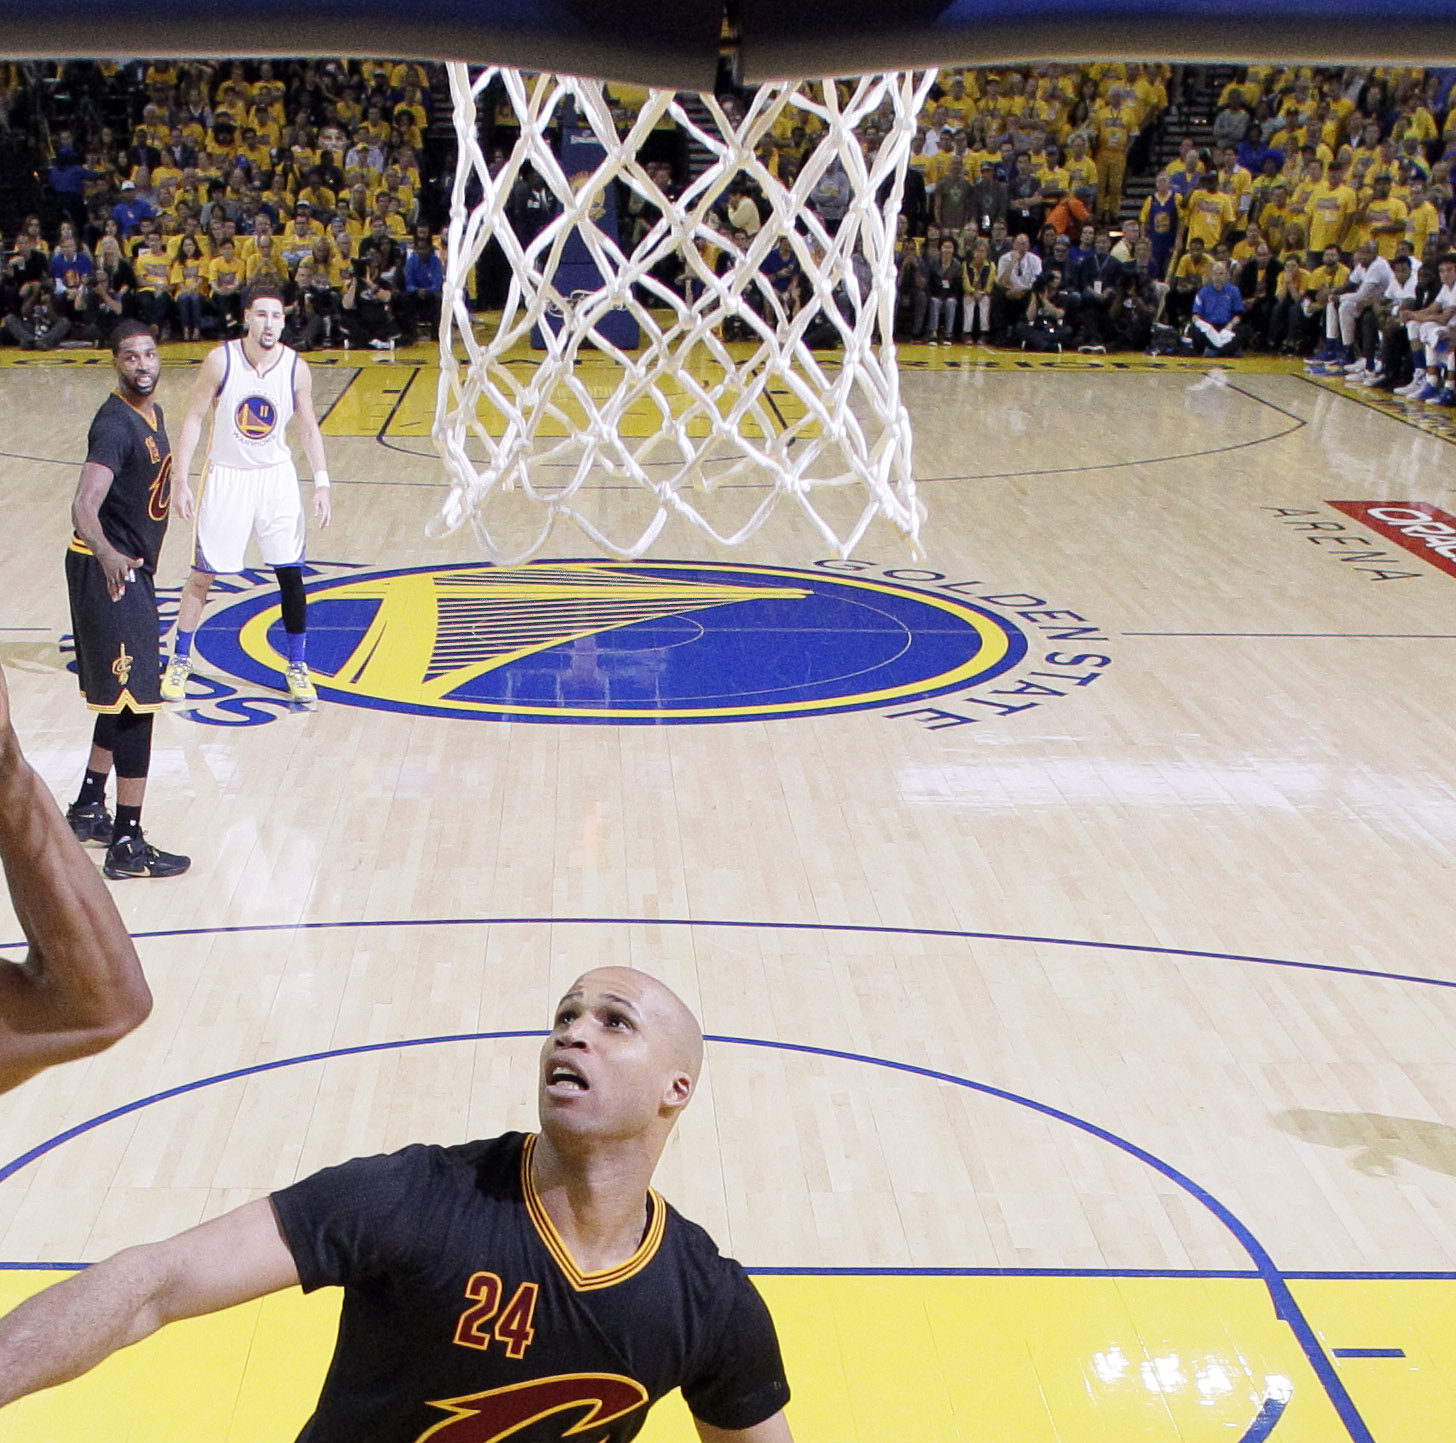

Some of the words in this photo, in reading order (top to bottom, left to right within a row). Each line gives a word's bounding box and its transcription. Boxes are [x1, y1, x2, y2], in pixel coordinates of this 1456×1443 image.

[1258, 506, 1425, 582] ARENA
[812, 558, 1110, 642] GOLDEN
[881, 651, 1113, 731] STATE
[452, 1270, 539, 1360] 24
